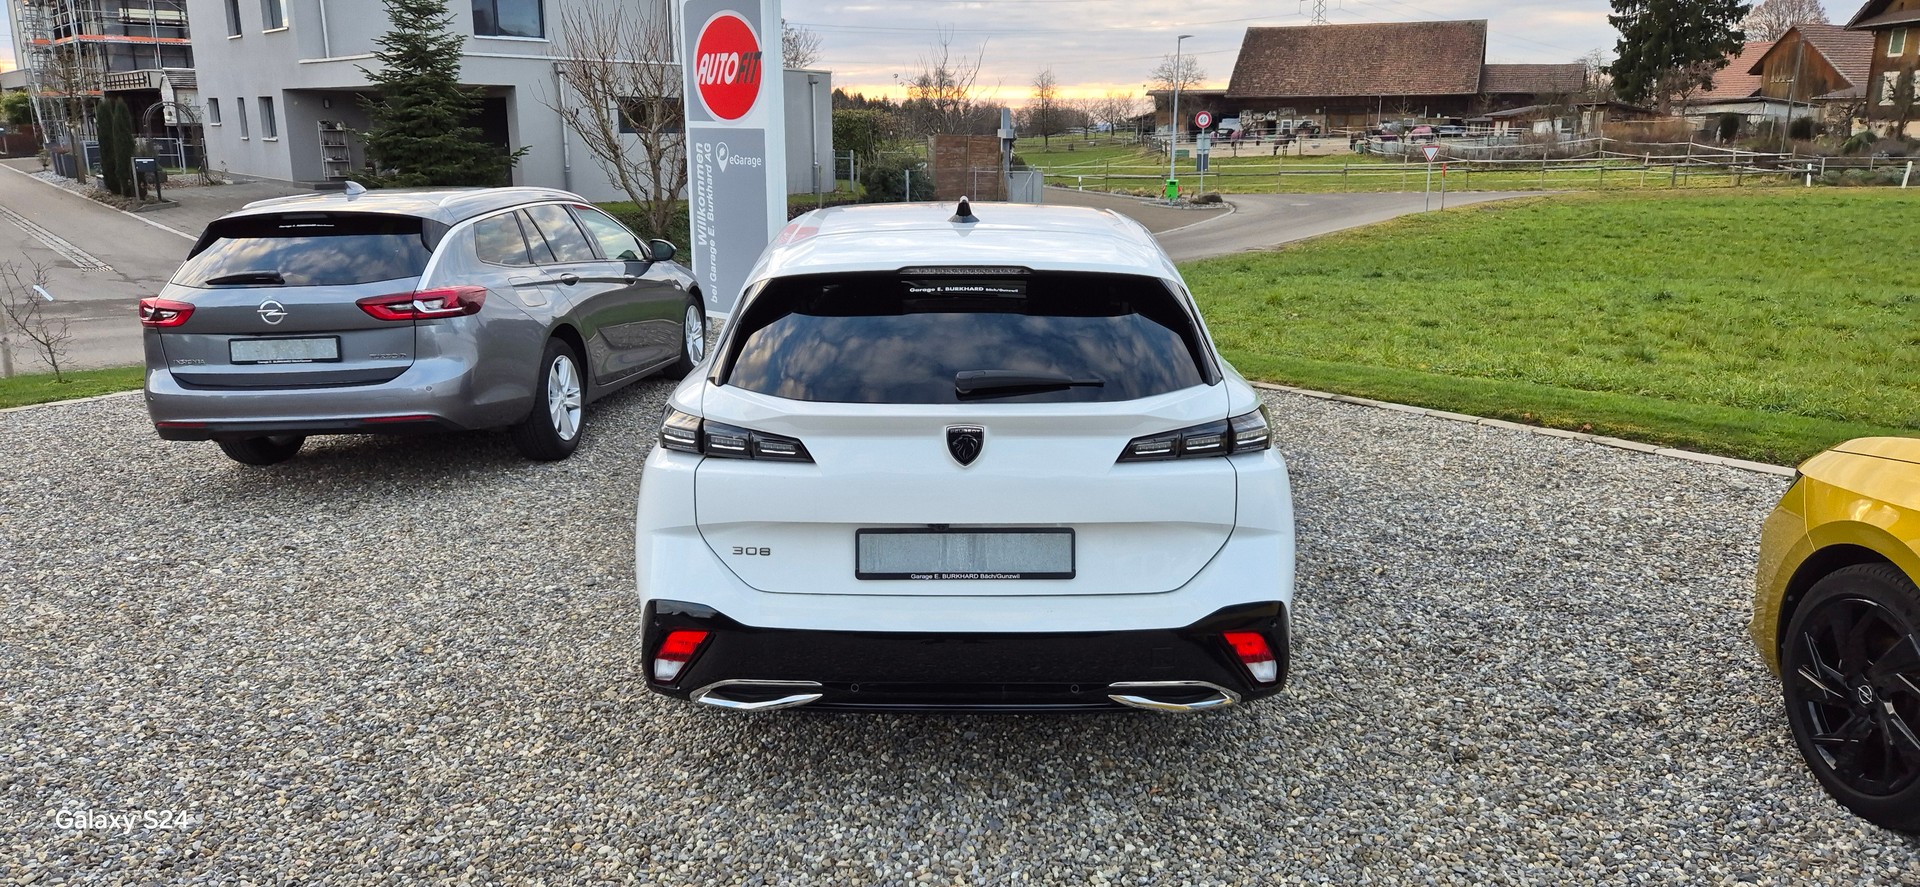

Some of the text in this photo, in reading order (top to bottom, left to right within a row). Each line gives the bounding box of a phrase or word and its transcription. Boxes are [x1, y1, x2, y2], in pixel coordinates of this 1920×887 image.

[697, 51, 762, 85] AUTOFIT
[704, 143, 712, 163] AG
[729, 154, 762, 168] eGarage
[696, 142, 707, 246] Willkommen
[705, 163, 714, 222] Burkhard
[707, 225, 715, 237] E.
[709, 239, 717, 282] Garage
[732, 546, 771, 556] 308
